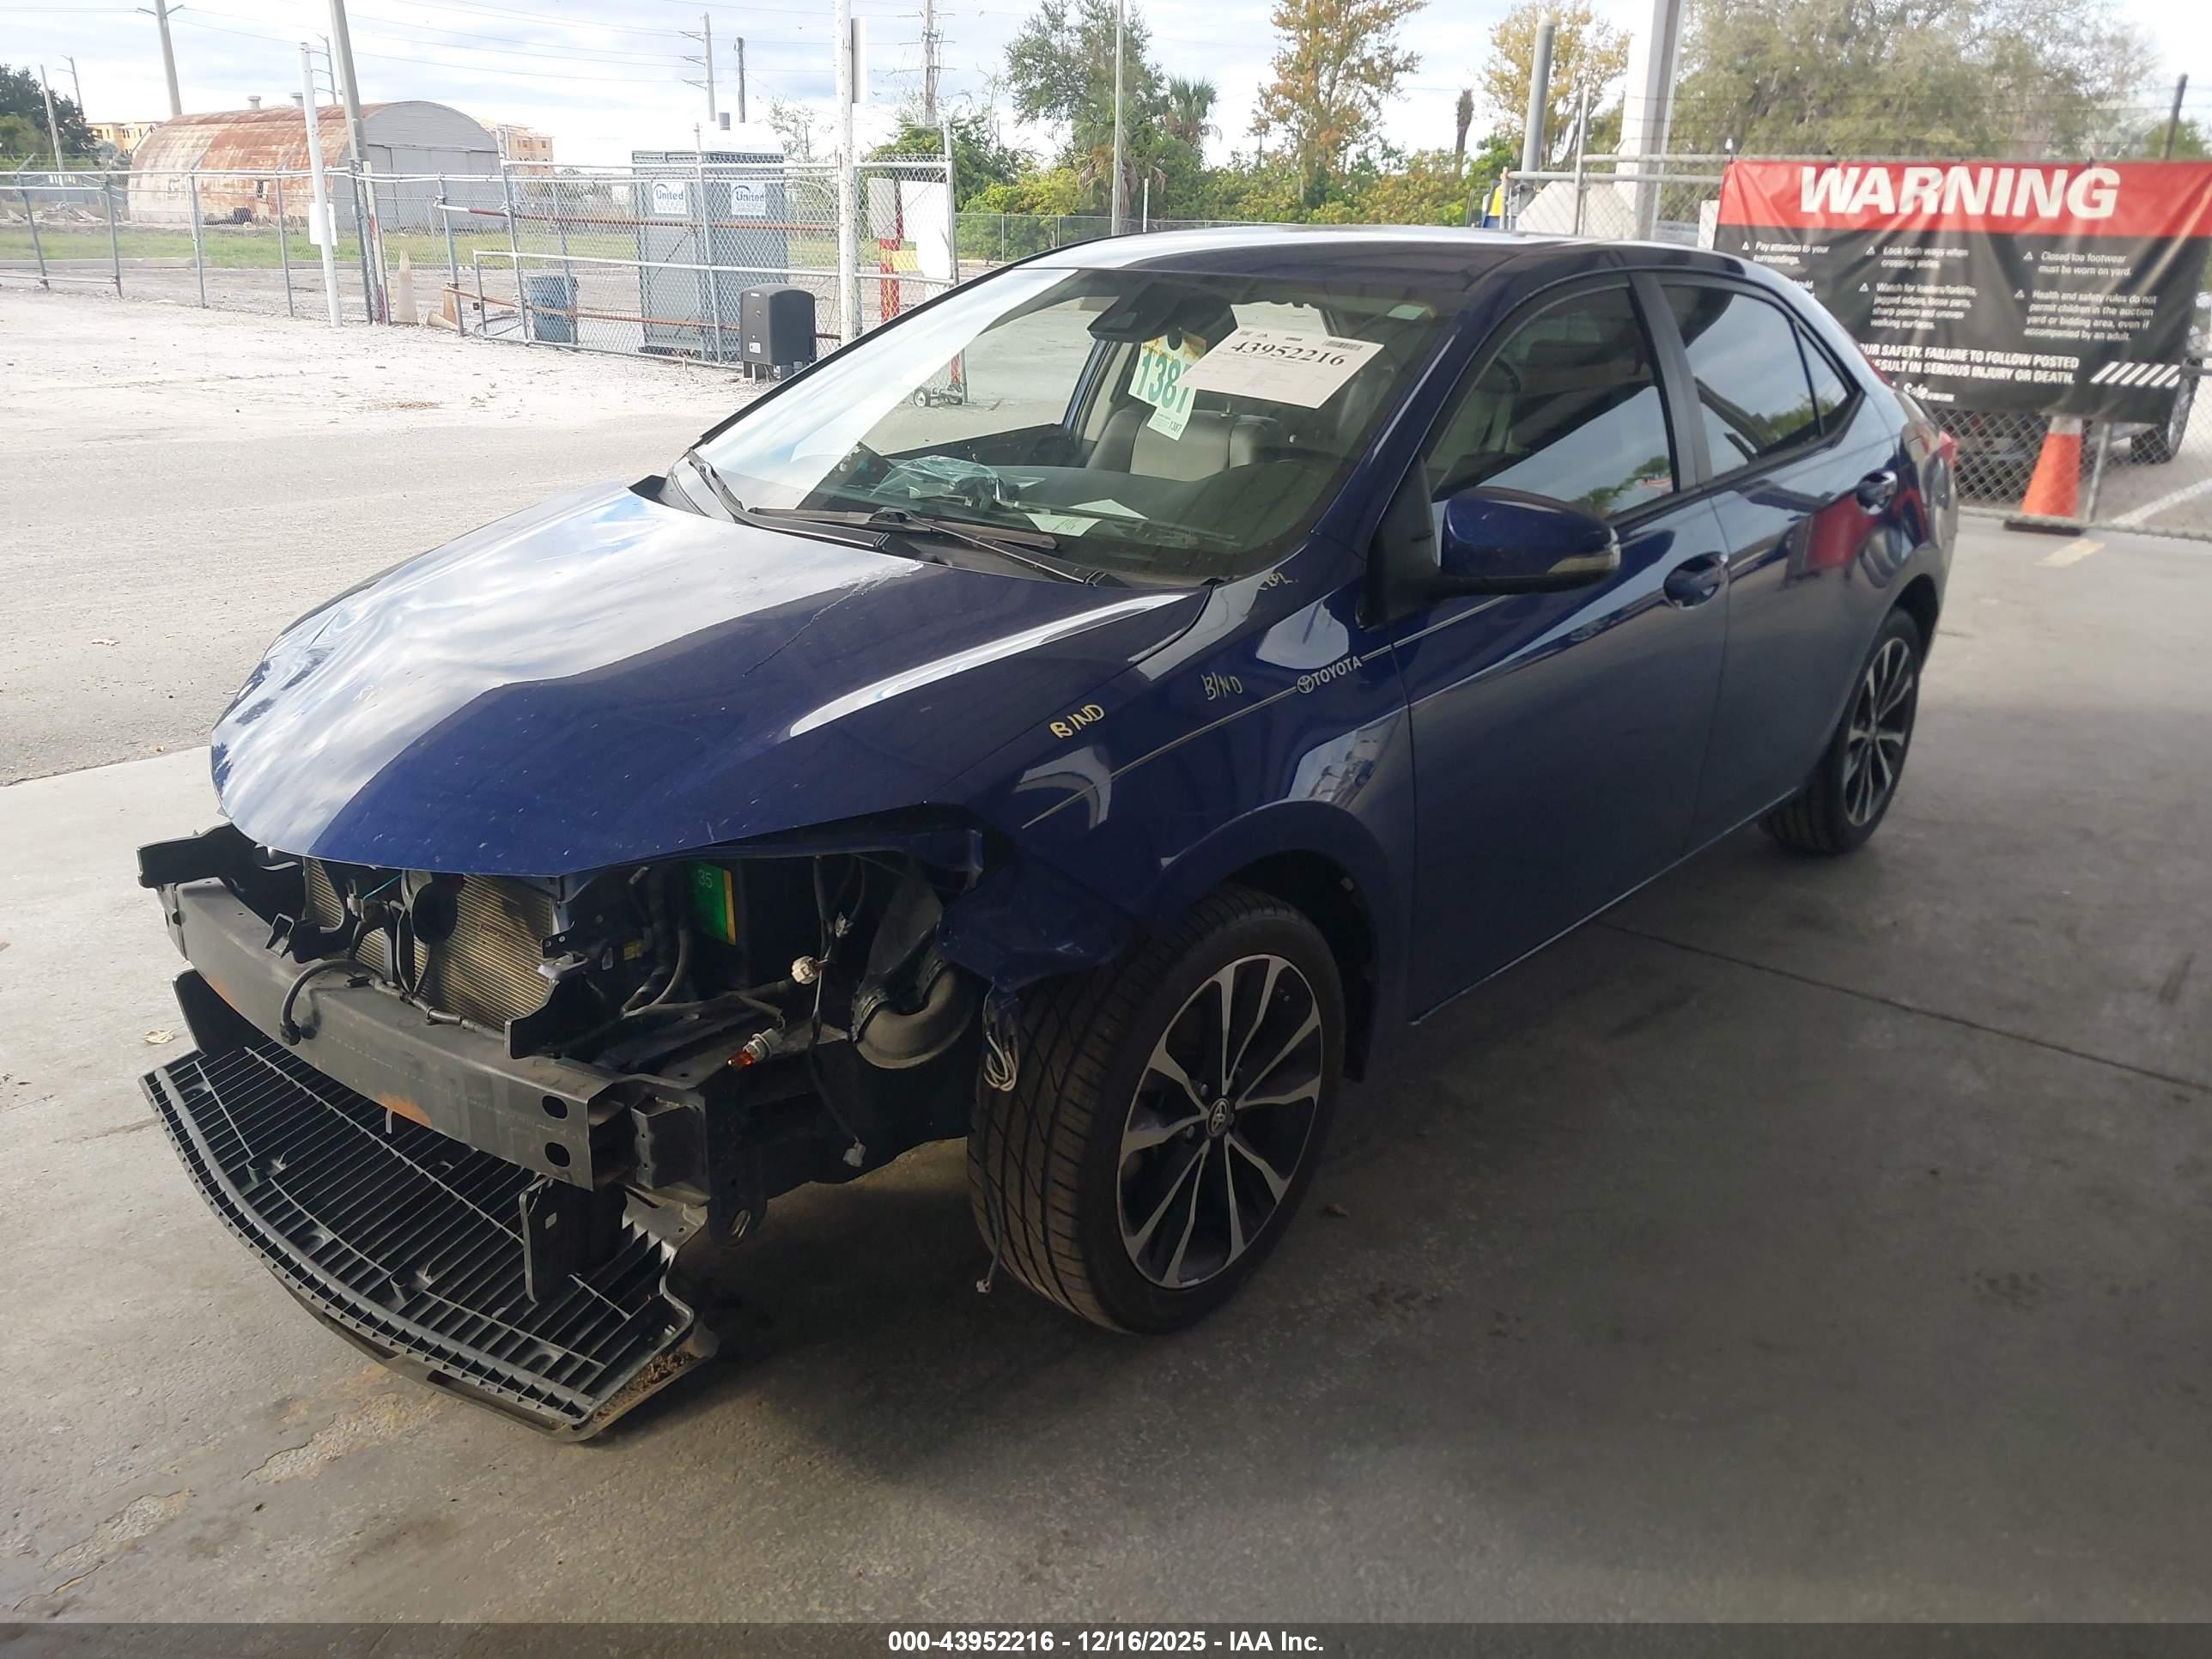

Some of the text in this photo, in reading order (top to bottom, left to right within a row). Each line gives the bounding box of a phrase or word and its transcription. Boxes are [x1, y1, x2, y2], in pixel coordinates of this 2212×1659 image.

[655, 189, 684, 200] United
[735, 191, 765, 203] United
[1800, 166, 2121, 220] WARNING
[1754, 240, 1831, 255] Pay attention to your
[1753, 253, 1801, 266] surroundings.
[2040, 251, 2127, 264] Closed toe footwear
[2038, 264, 2132, 278] must be worn on yard.
[2032, 289, 2157, 305] Health and safety rules do not
[2028, 303, 2154, 317] permit children in the auction
[2026, 315, 2047, 325] yard
[2047, 317, 2058, 326] or
[2059, 316, 2092, 329] bidding
[2118, 322, 2141, 331] even
[2142, 319, 2151, 331] if
[2023, 326, 2081, 340] accompanied
[2081, 328, 2092, 341] by
[2094, 331, 2106, 341] an
[1231, 340, 1347, 367] 43952216
[1923, 346, 1970, 362] FAILURE
[1969, 349, 1985, 363] TO
[1984, 349, 2033, 367] FOLLOW
[2032, 353, 2080, 370] POSTED
[1908, 359, 1923, 374] IN
[1923, 362, 1971, 378] SERIOUS
[1970, 364, 2015, 380] INJURY
[2014, 368, 2033, 383] OR
[2032, 369, 2075, 386] DEATH.
[1311, 656, 1364, 687] TOYOTA
[1202, 671, 1243, 701] BIND
[696, 868, 714, 889] 35
